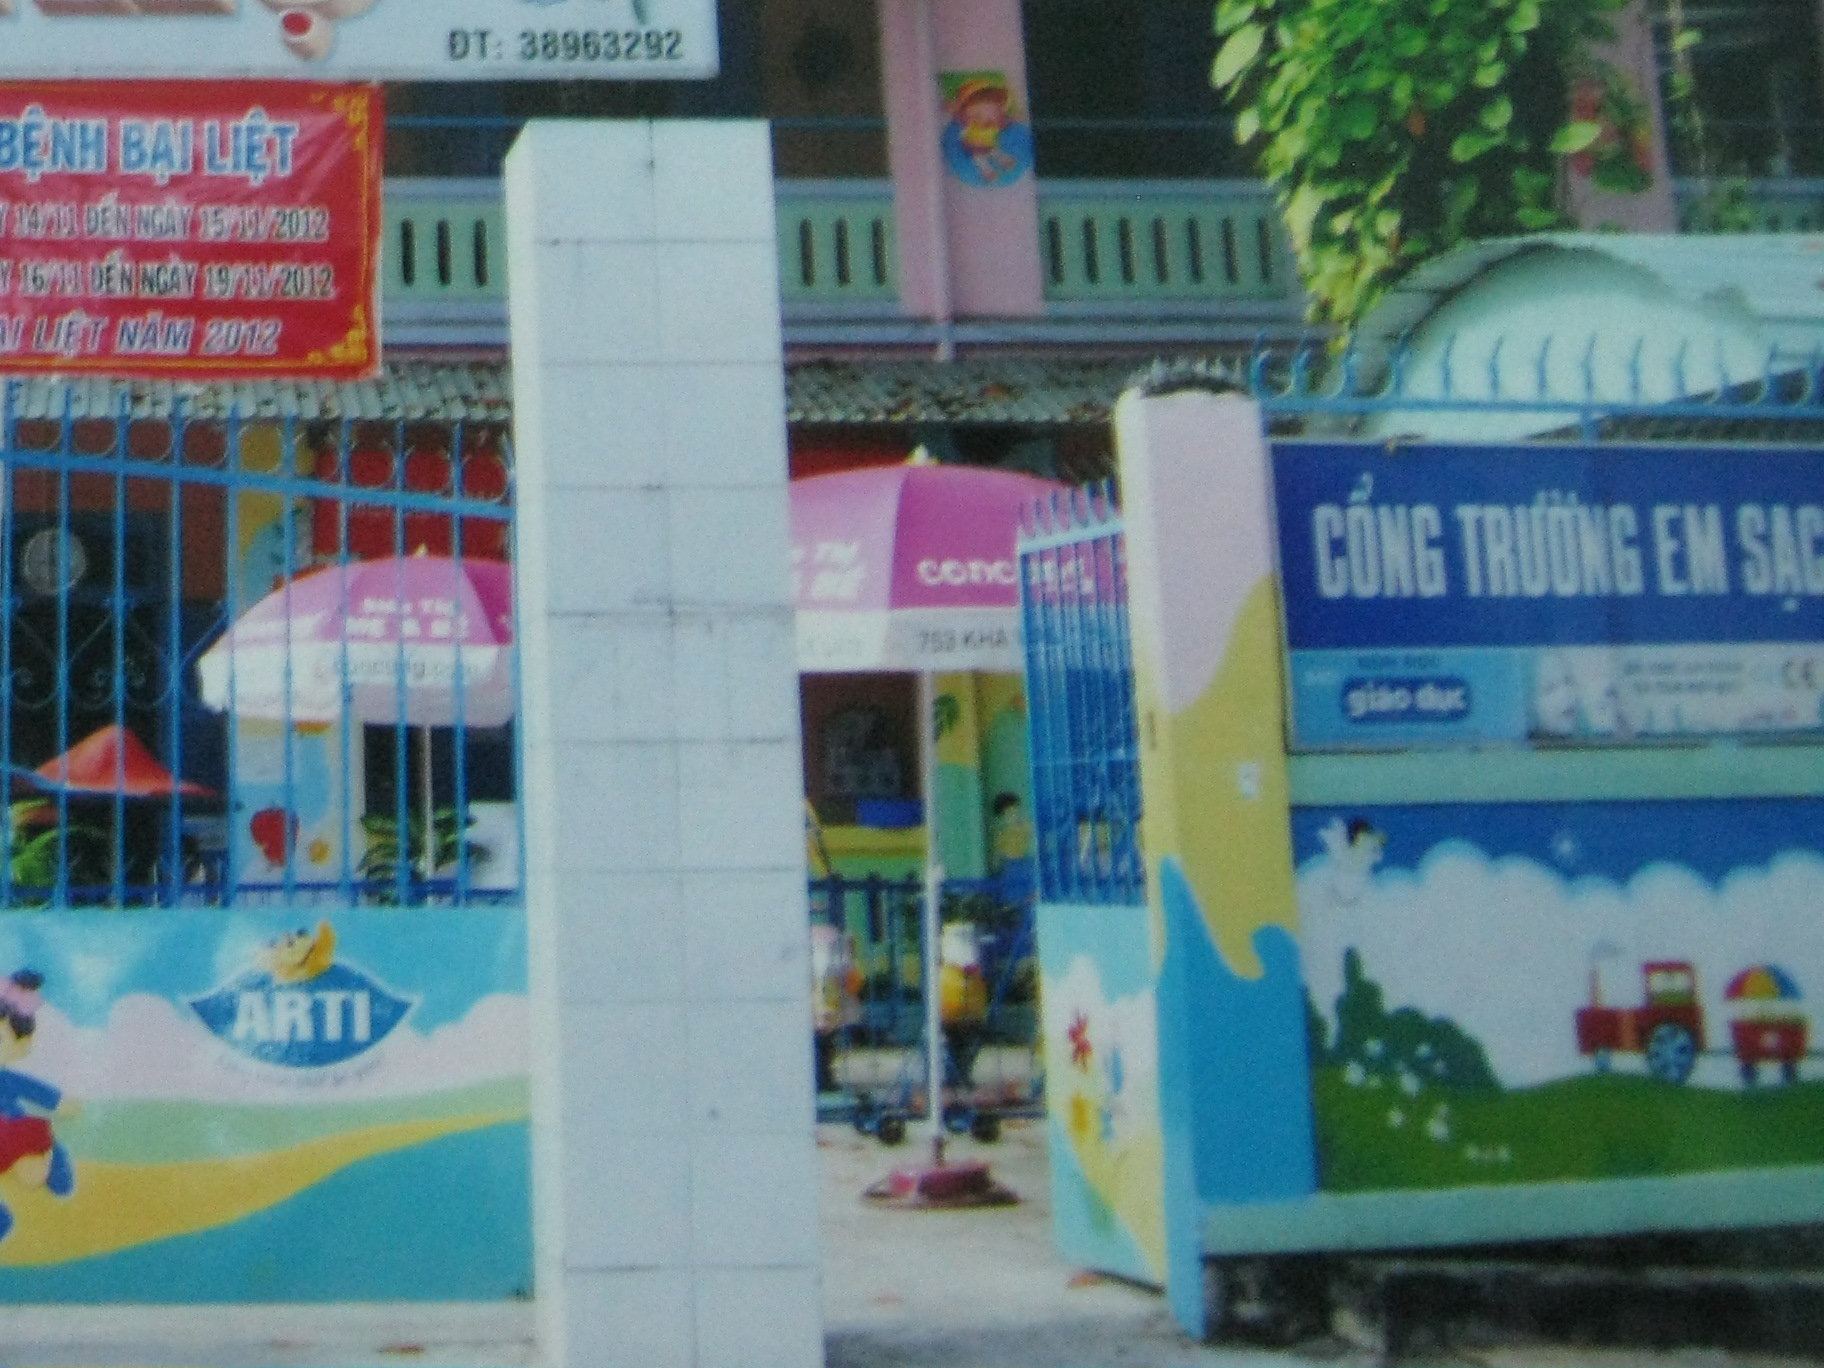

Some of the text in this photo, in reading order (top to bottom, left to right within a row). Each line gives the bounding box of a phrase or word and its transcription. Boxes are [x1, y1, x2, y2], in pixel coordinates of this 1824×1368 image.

[519, 28, 684, 62] 38963292
[120, 117, 194, 186] BẠI
[205, 107, 300, 186] LIỆT
[138, 252, 198, 300] NGÀY
[31, 310, 110, 359] LIỆT
[114, 311, 196, 355] NĂM
[199, 317, 284, 355] 2012
[1312, 471, 1447, 599] CỔNG
[1455, 488, 1645, 599] TRƯỜNG
[1653, 503, 1729, 596] EM
[232, 990, 372, 1046] ARTI
